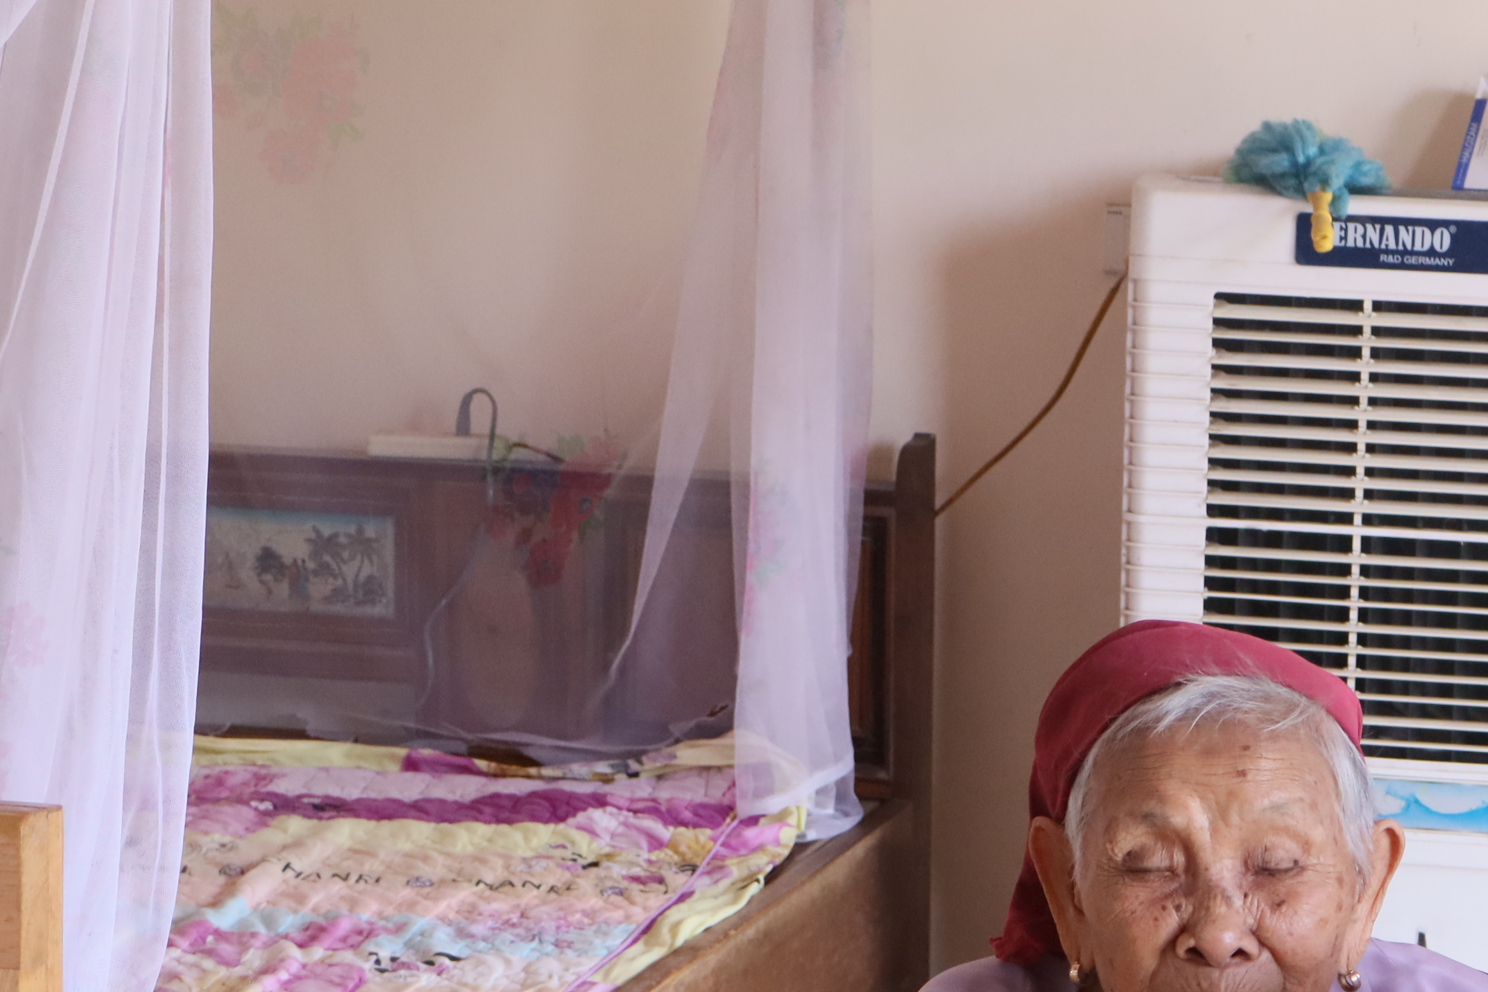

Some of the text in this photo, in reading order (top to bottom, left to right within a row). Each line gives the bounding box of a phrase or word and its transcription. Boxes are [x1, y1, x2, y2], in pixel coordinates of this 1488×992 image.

[1331, 221, 1451, 253] ERNANDO
[1380, 254, 1455, 267] R&D GERMANY
